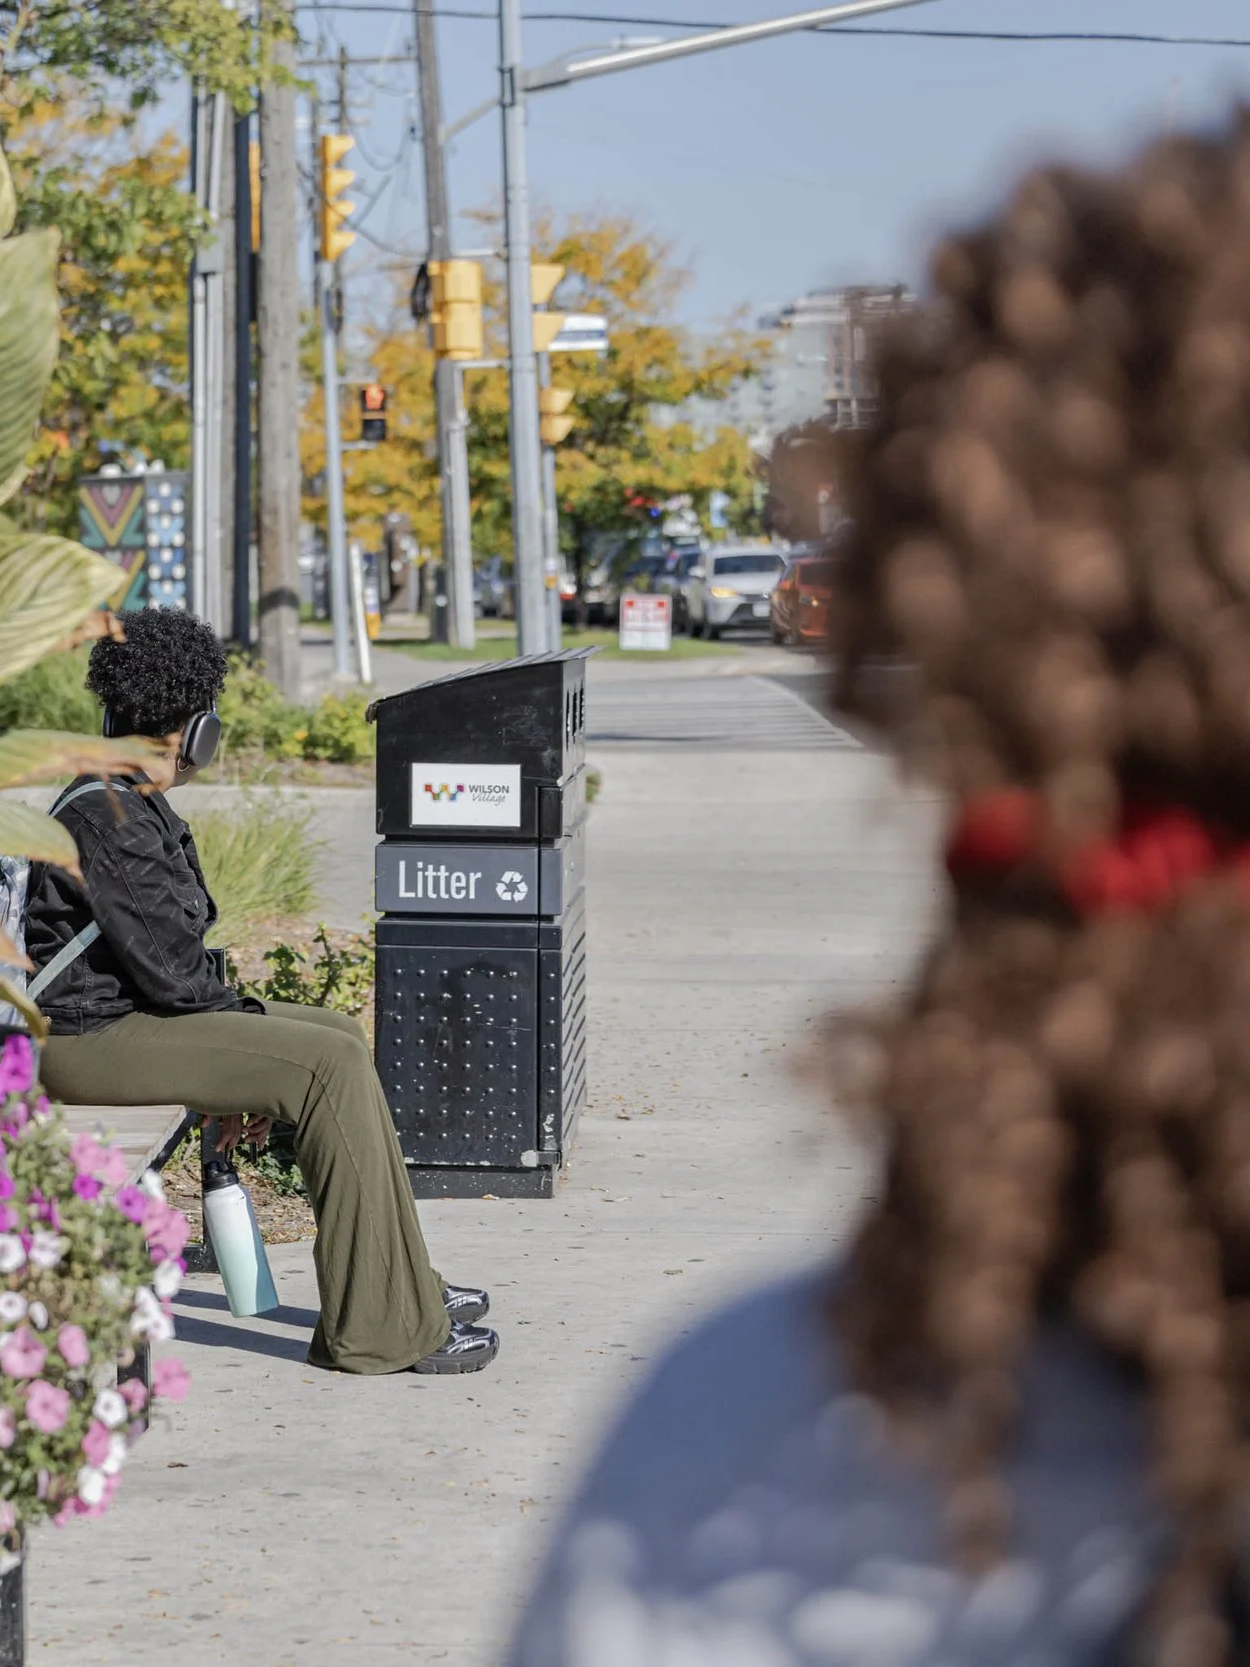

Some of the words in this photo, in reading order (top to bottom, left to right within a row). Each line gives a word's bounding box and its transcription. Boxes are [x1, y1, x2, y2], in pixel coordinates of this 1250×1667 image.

[468, 784, 510, 794] WILSON
[472, 793, 506, 806] Village
[398, 860, 482, 899] Litter
